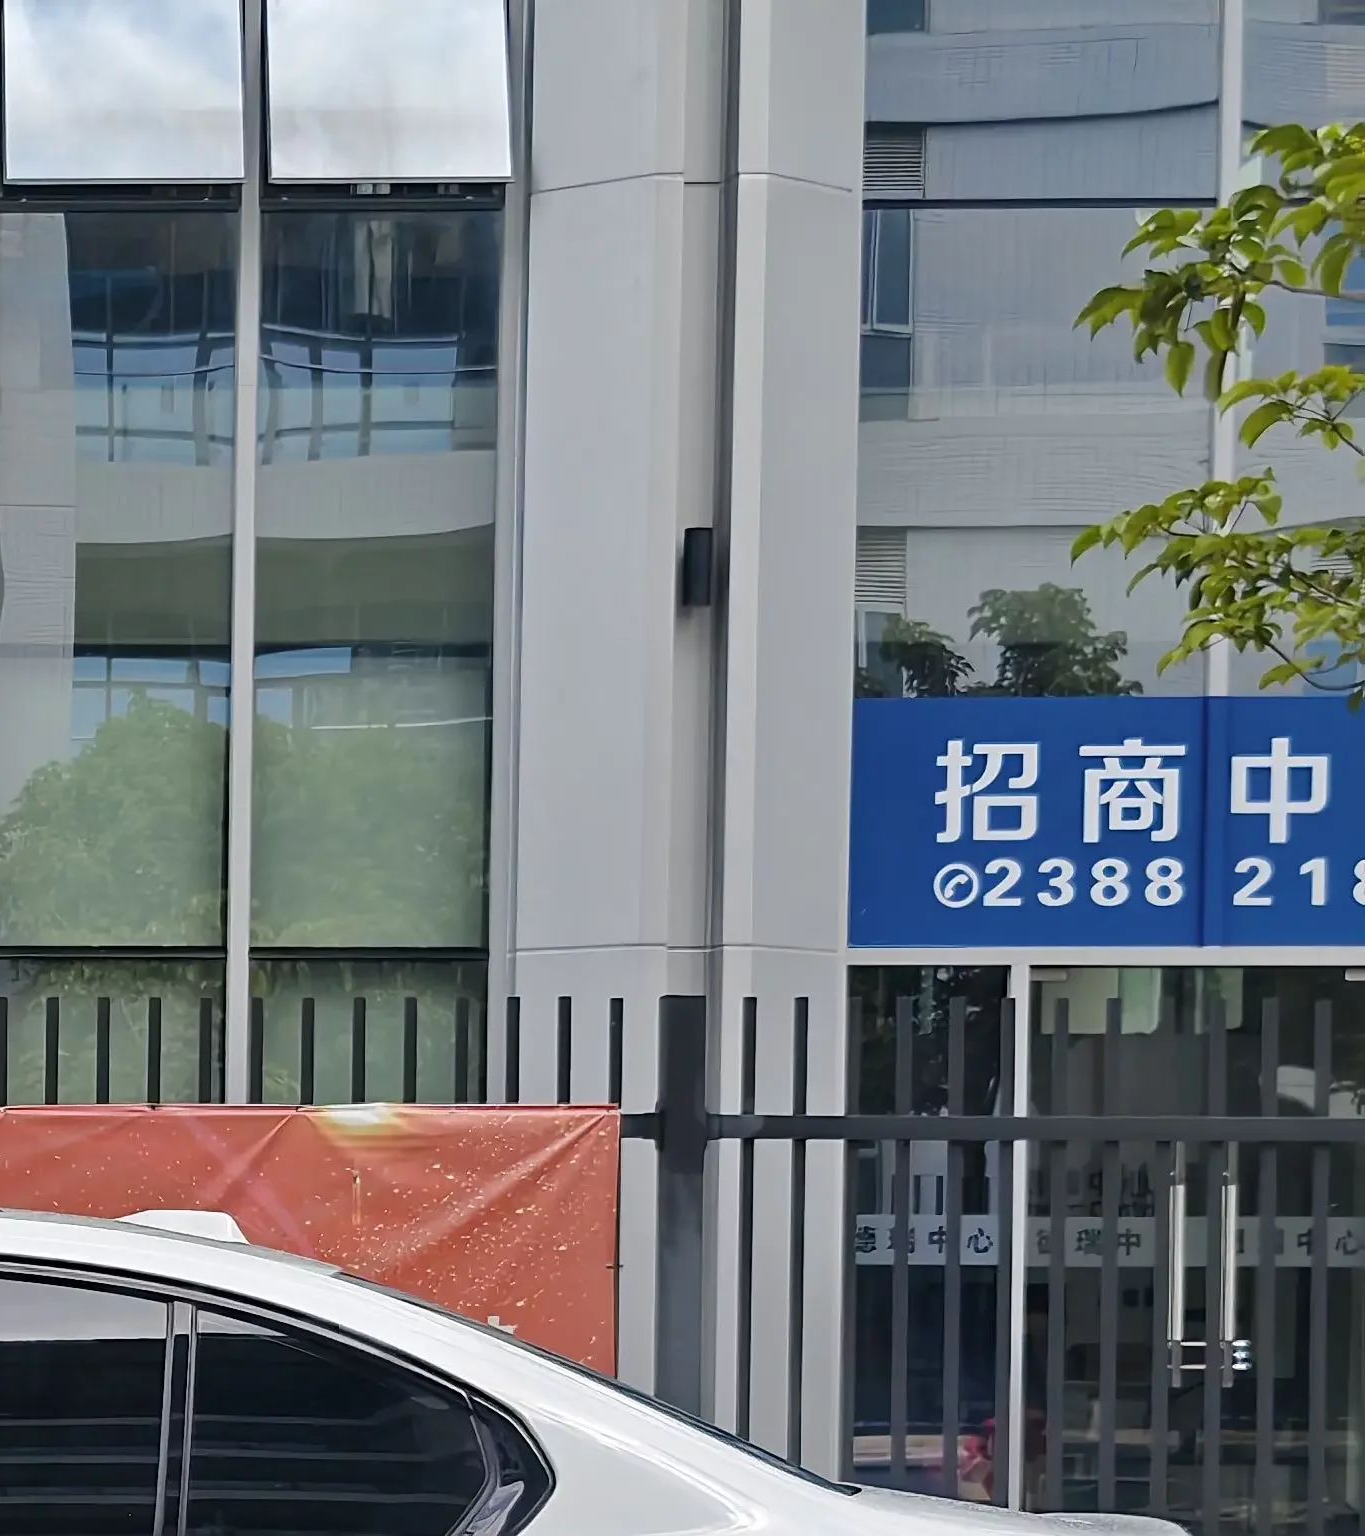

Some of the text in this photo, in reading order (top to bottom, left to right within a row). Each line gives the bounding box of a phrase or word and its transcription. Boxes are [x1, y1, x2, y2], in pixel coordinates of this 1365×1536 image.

[933, 737, 1331, 844] 招商中
[982, 858, 1185, 908] 2388
